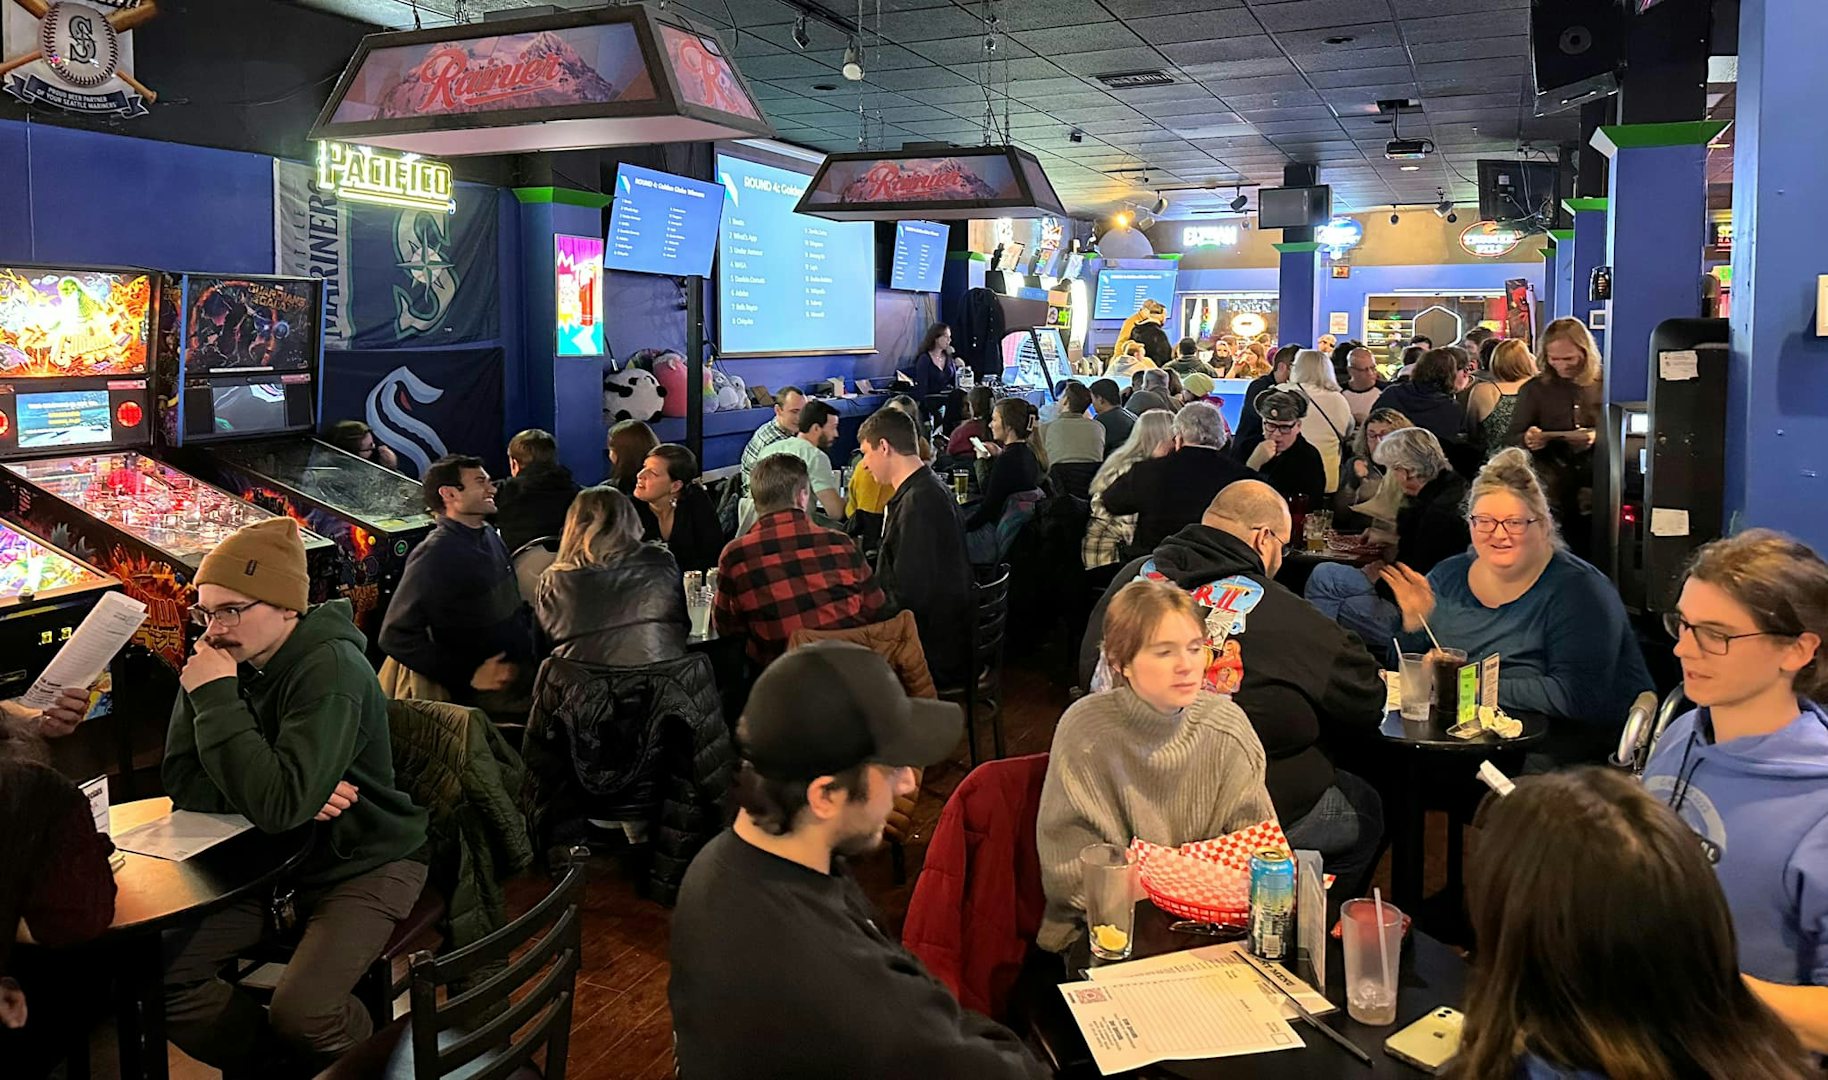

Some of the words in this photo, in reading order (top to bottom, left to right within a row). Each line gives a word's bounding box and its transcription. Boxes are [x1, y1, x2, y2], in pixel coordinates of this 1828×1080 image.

[416, 48, 562, 111] Rainier
[678, 38, 739, 113] R
[36, 88, 45, 96] OF
[47, 94, 62, 102] YOUR
[64, 99, 87, 108] SEATTLE
[48, 87, 67, 97] PROUD
[68, 93, 82, 101] BEER
[317, 140, 452, 198] PACIFICO
[744, 175, 772, 191] ROUND
[867, 164, 961, 199] Rainier
